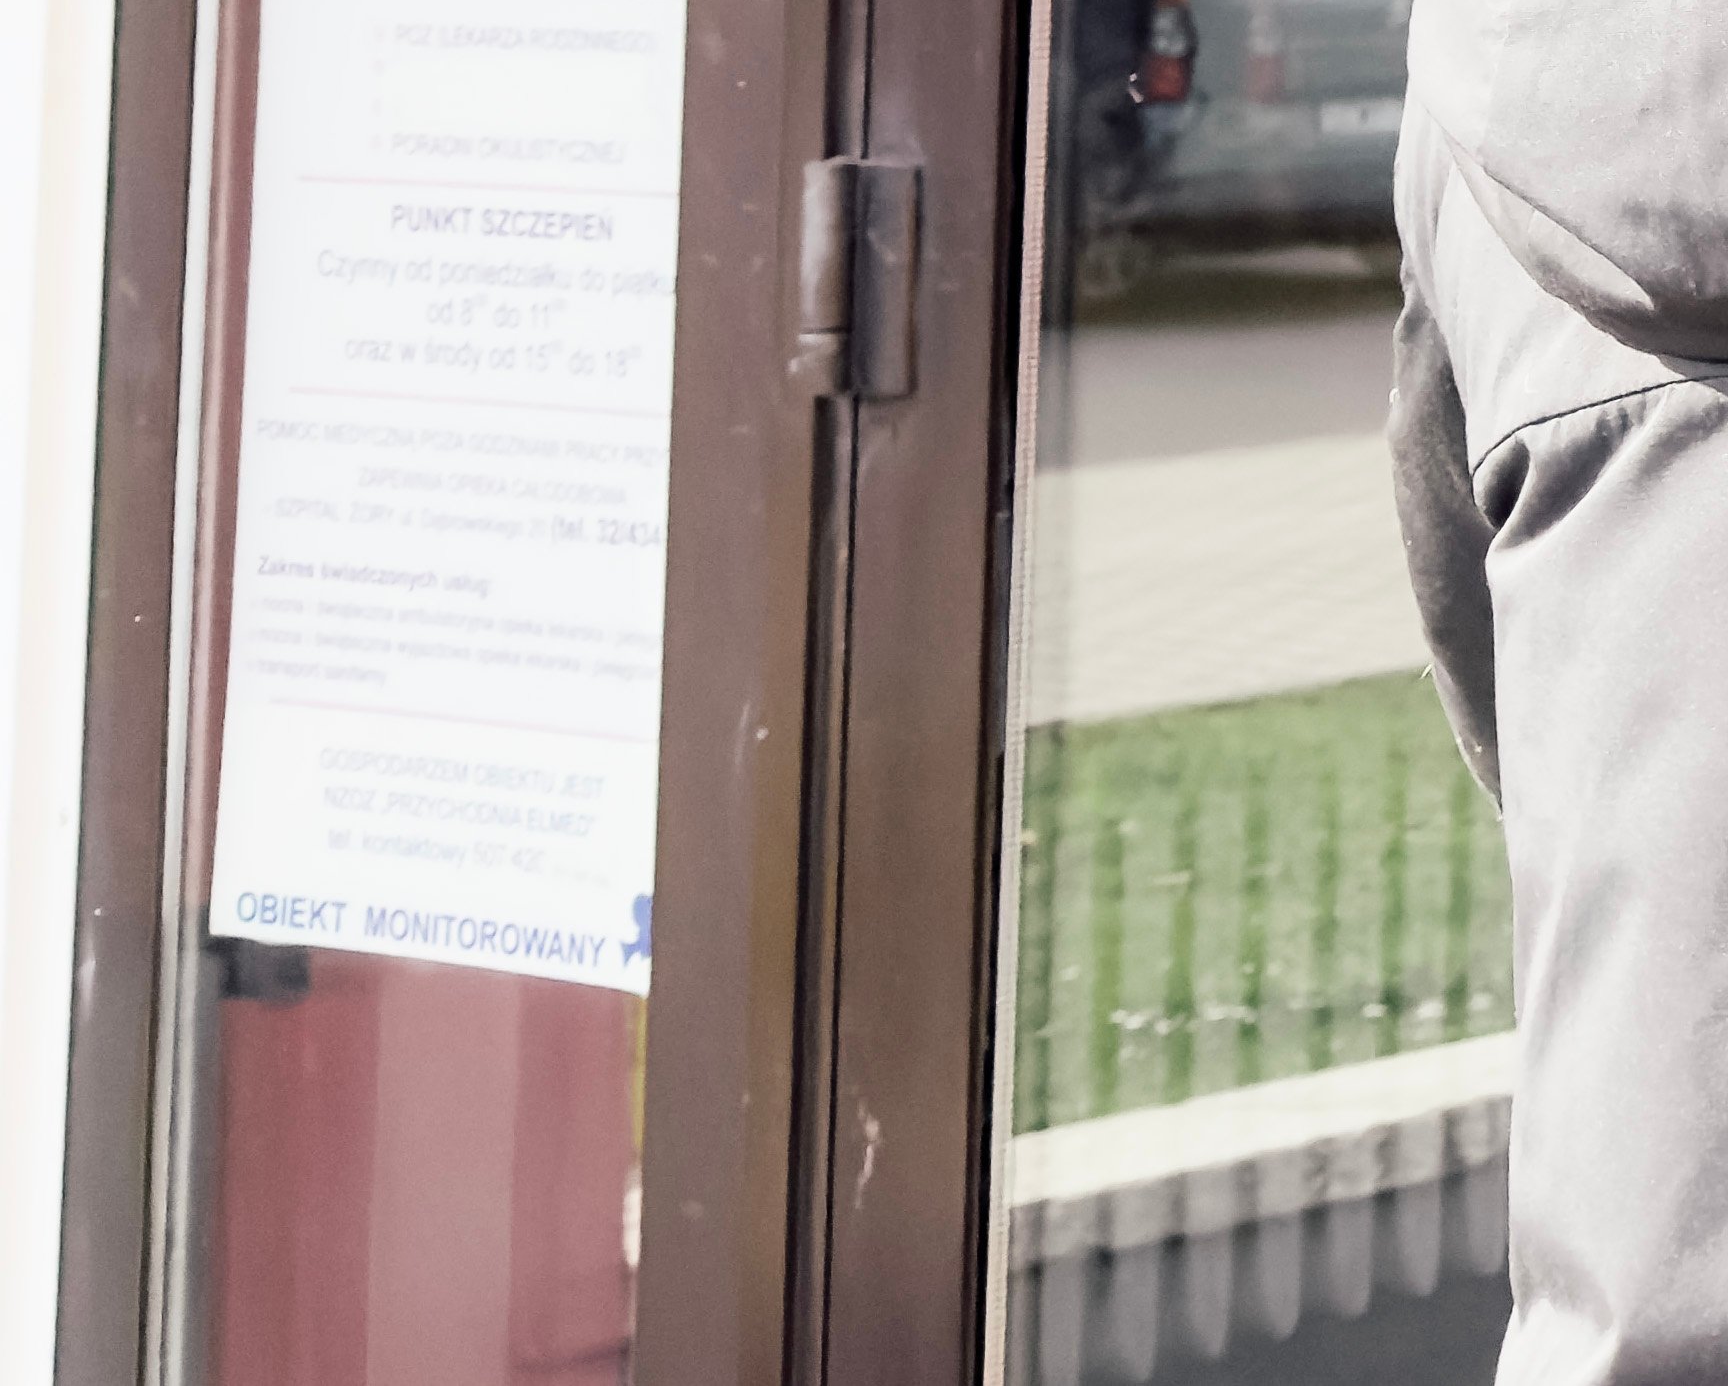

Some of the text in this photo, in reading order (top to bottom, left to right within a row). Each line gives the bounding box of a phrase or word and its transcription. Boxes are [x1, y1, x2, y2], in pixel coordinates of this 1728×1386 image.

[391, 204, 474, 235] PUNKT
[237, 891, 608, 968] OBIEKT MONITOROWANY
